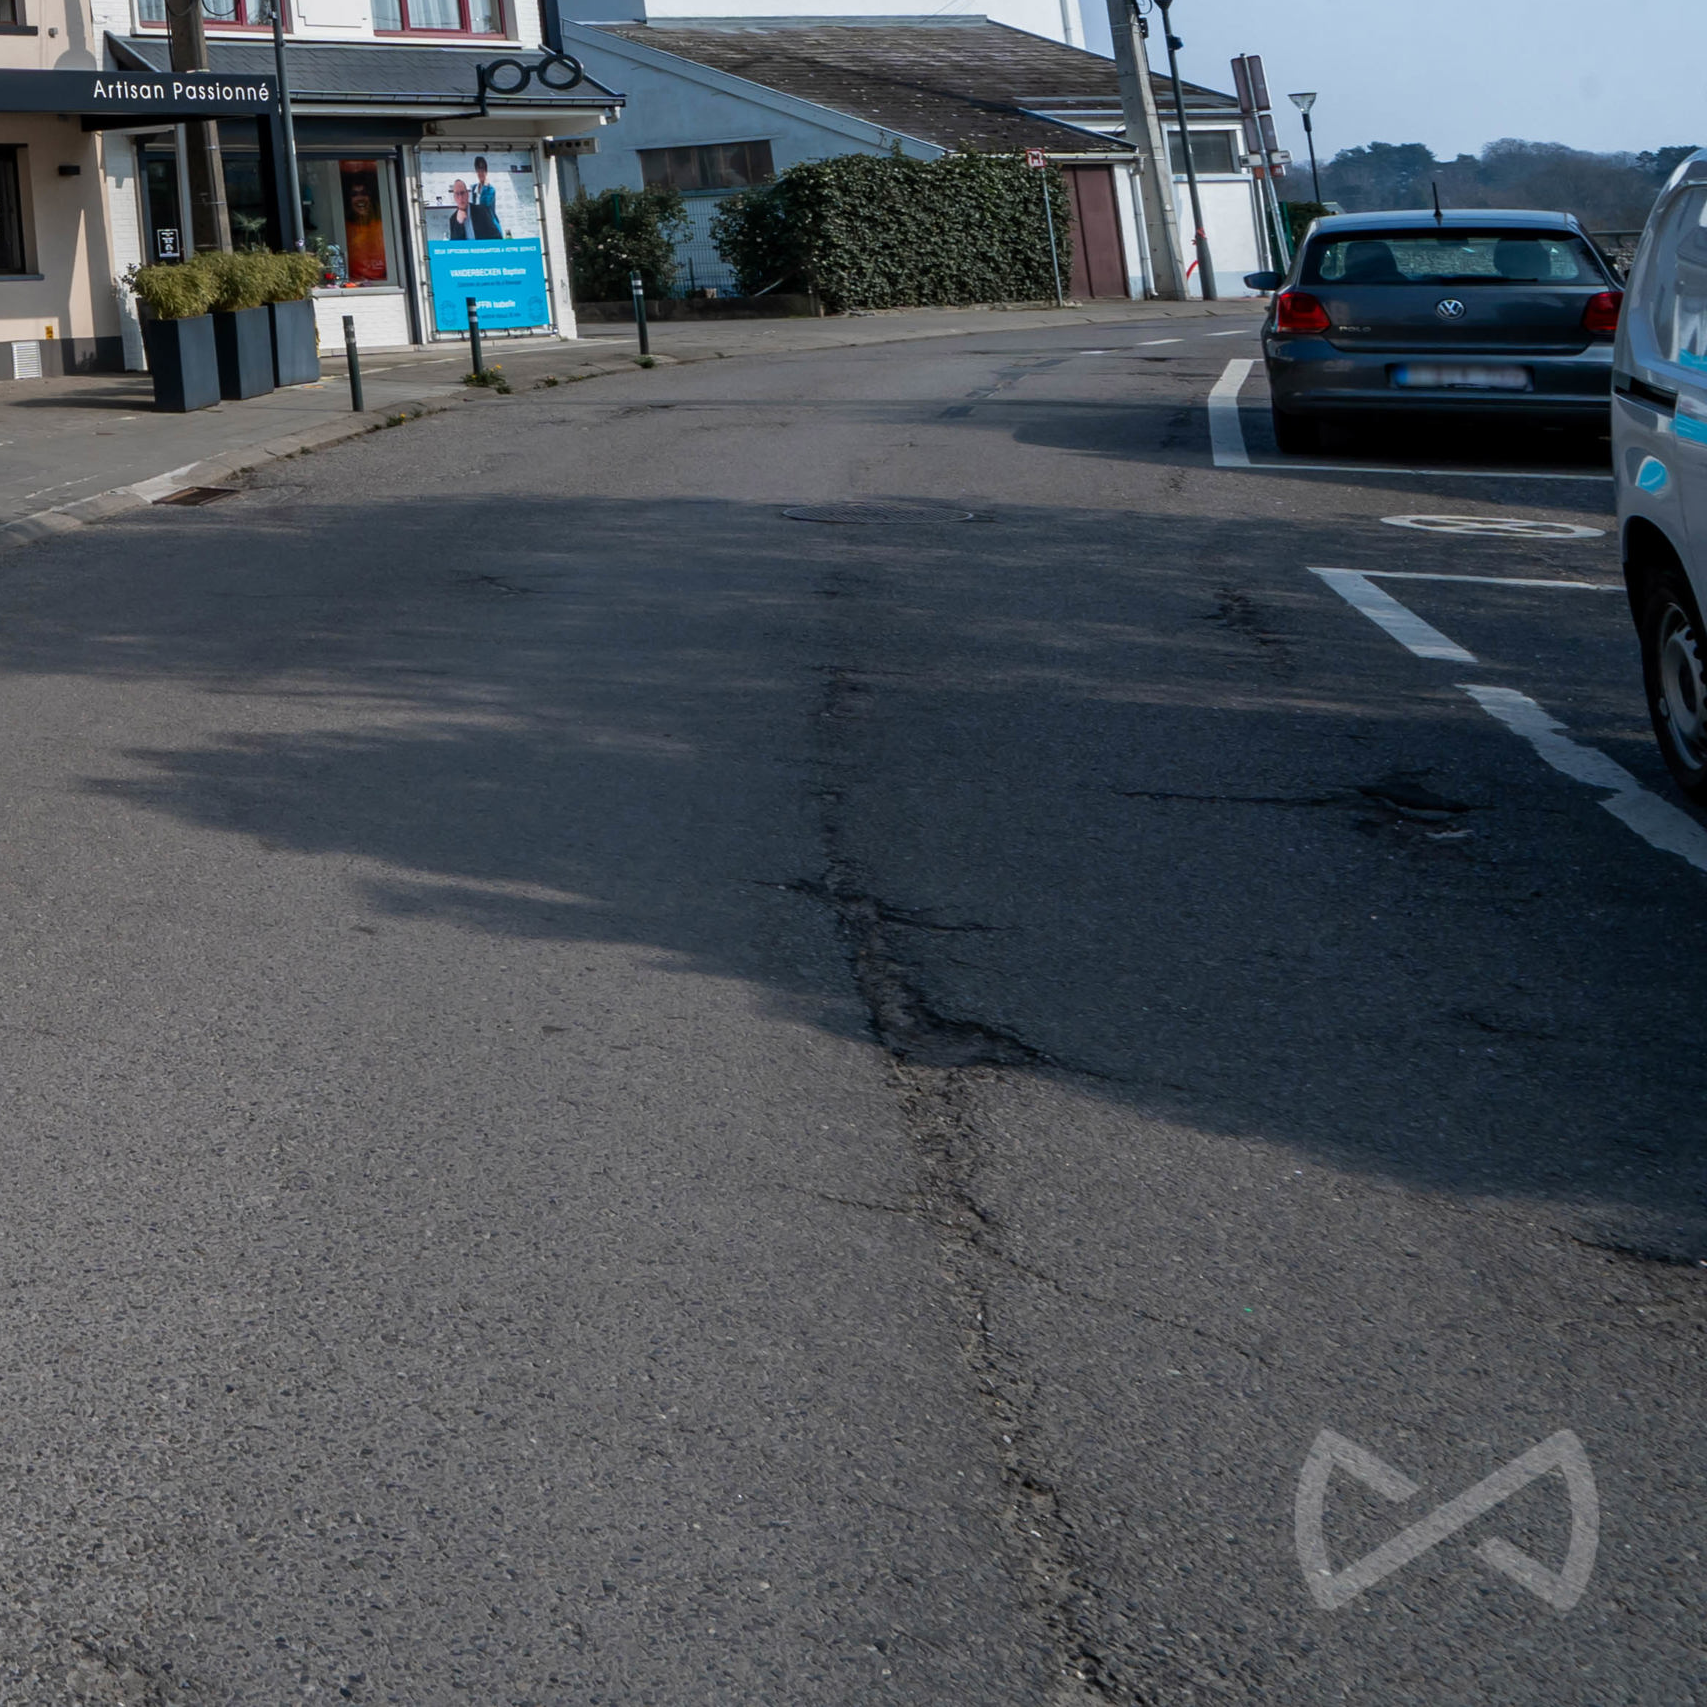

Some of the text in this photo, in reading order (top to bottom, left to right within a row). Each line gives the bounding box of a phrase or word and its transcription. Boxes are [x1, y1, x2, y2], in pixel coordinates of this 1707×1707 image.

[93, 79, 270, 101] Artisan Passionné
[1338, 325, 1372, 333] POLO
